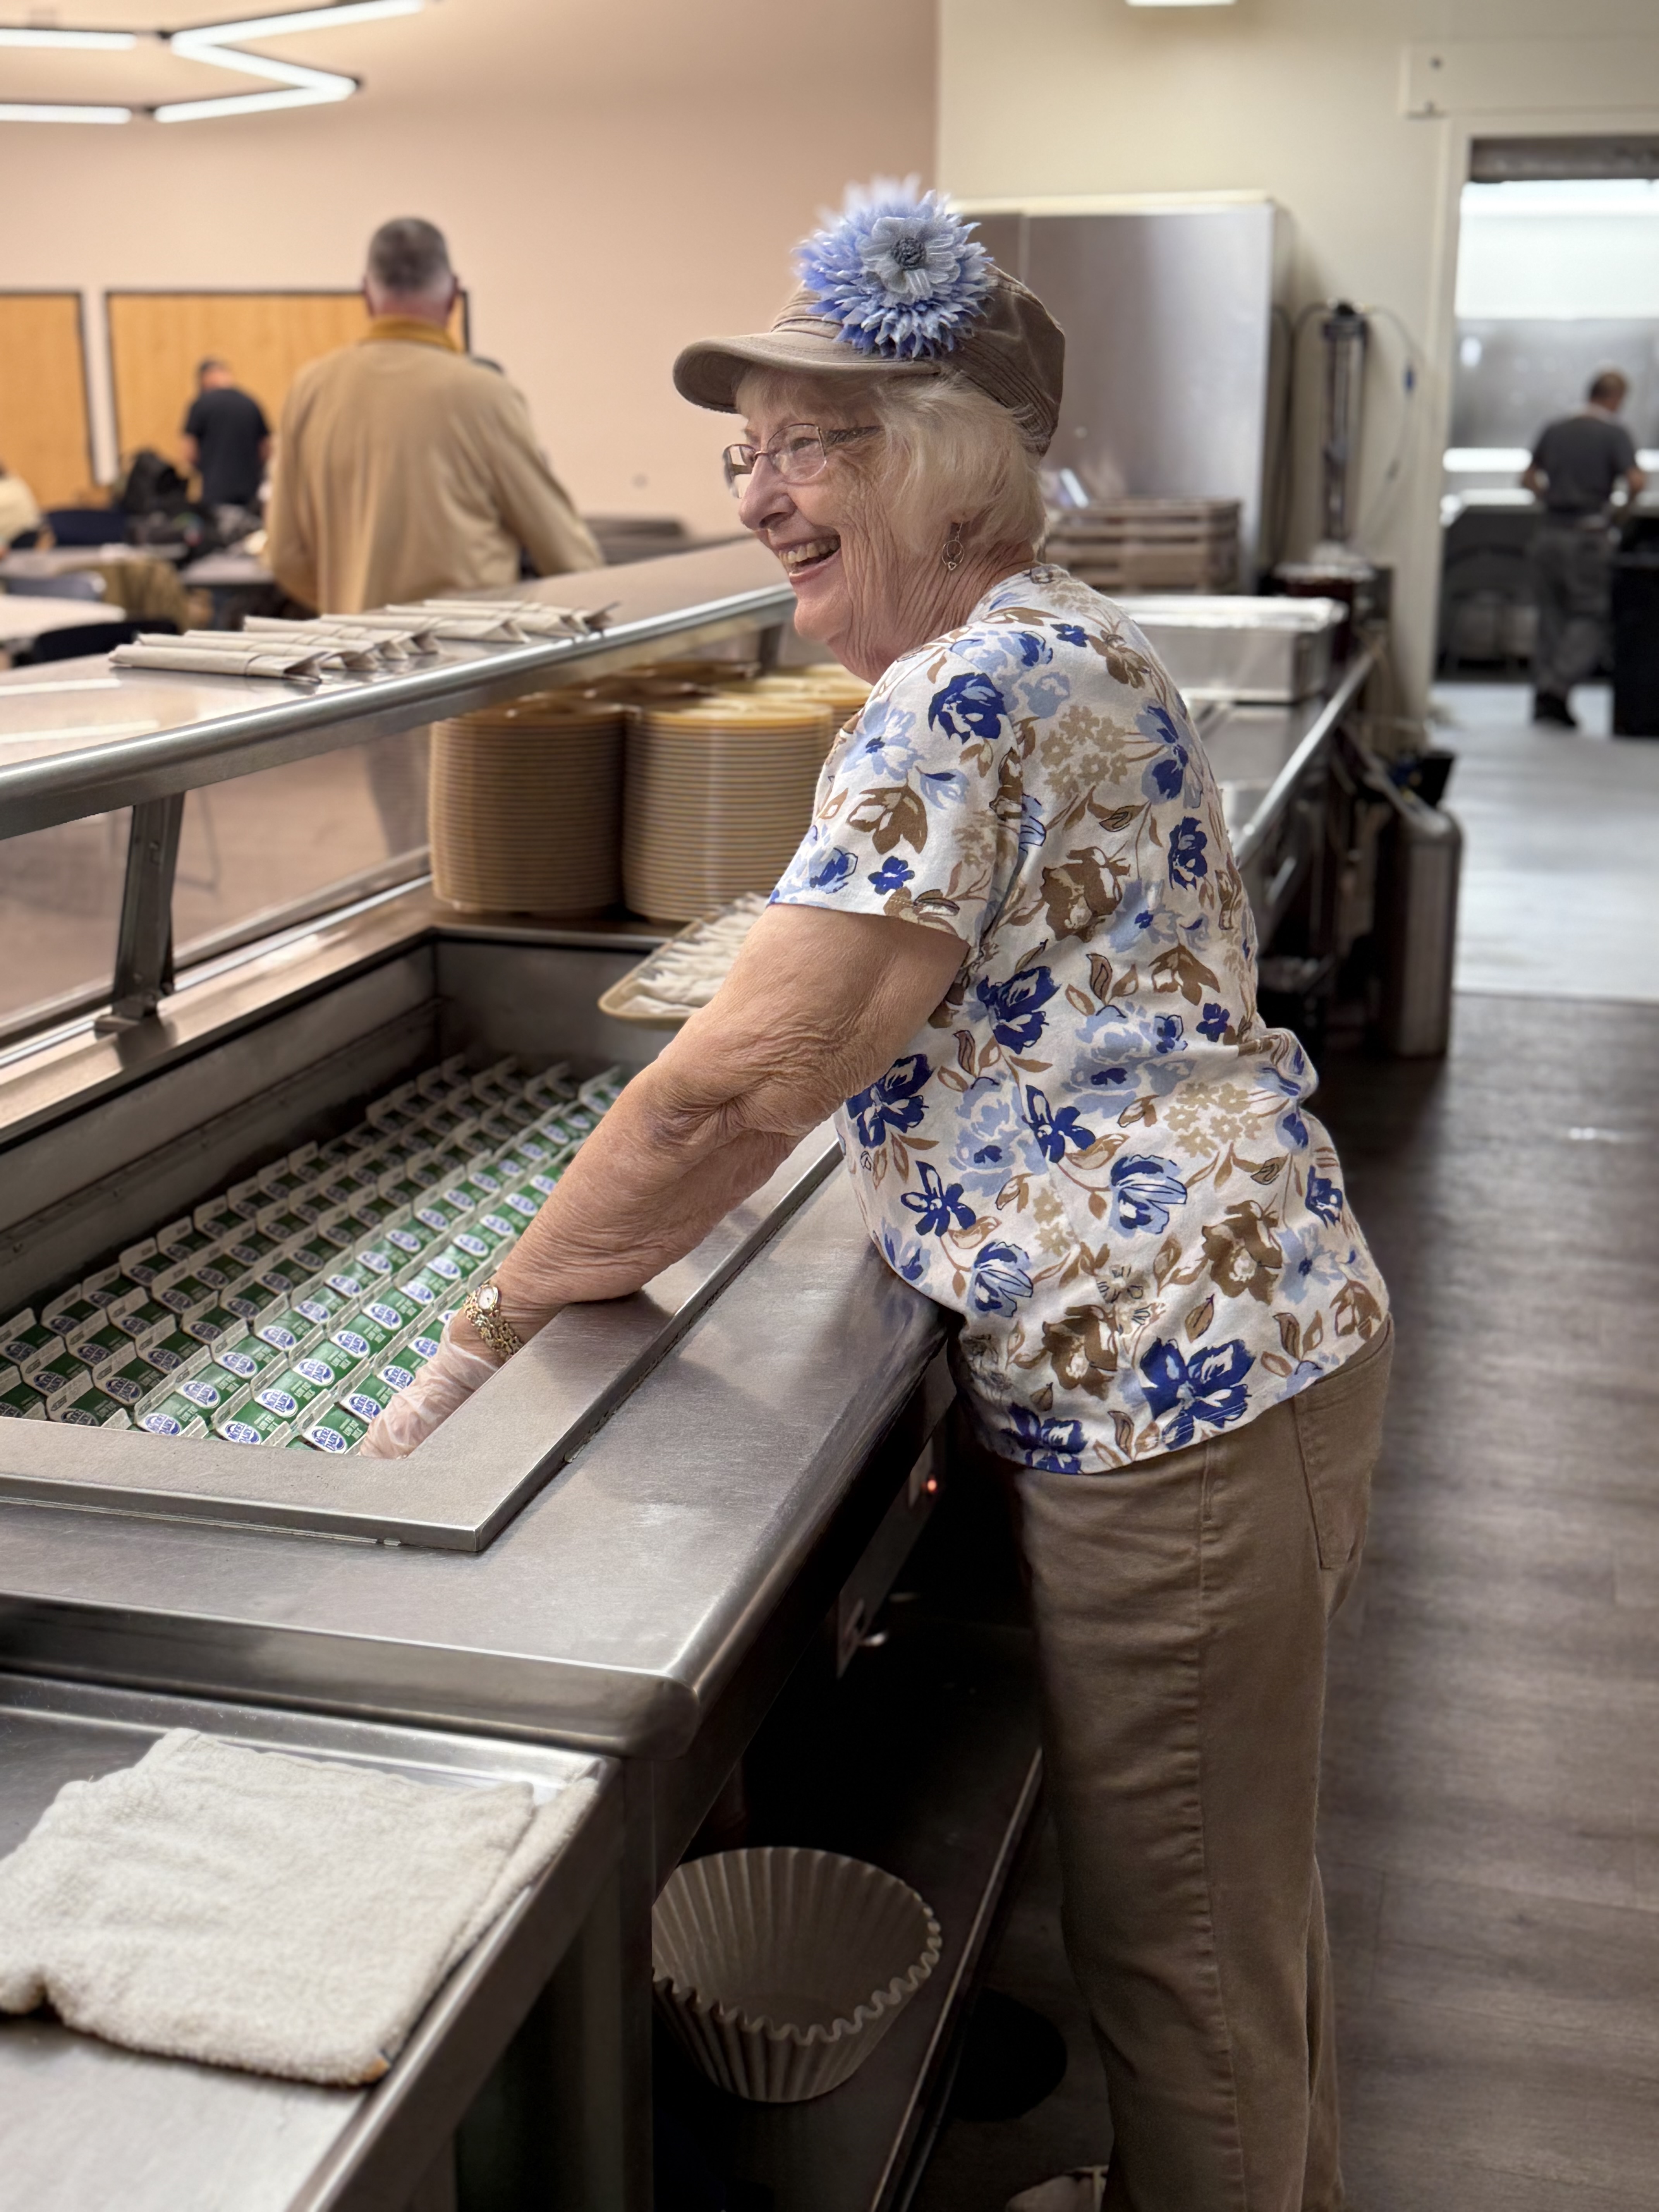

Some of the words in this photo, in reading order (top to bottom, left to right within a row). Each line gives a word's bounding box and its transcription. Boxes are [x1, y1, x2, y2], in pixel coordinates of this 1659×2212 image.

[264, 1390, 282, 1409] MODEL
[275, 1395, 289, 1413] DAIRY
[228, 1422, 246, 1440] MODEL
[314, 1427, 331, 1446] MODEL
[326, 1433, 339, 1451] DAIRY
